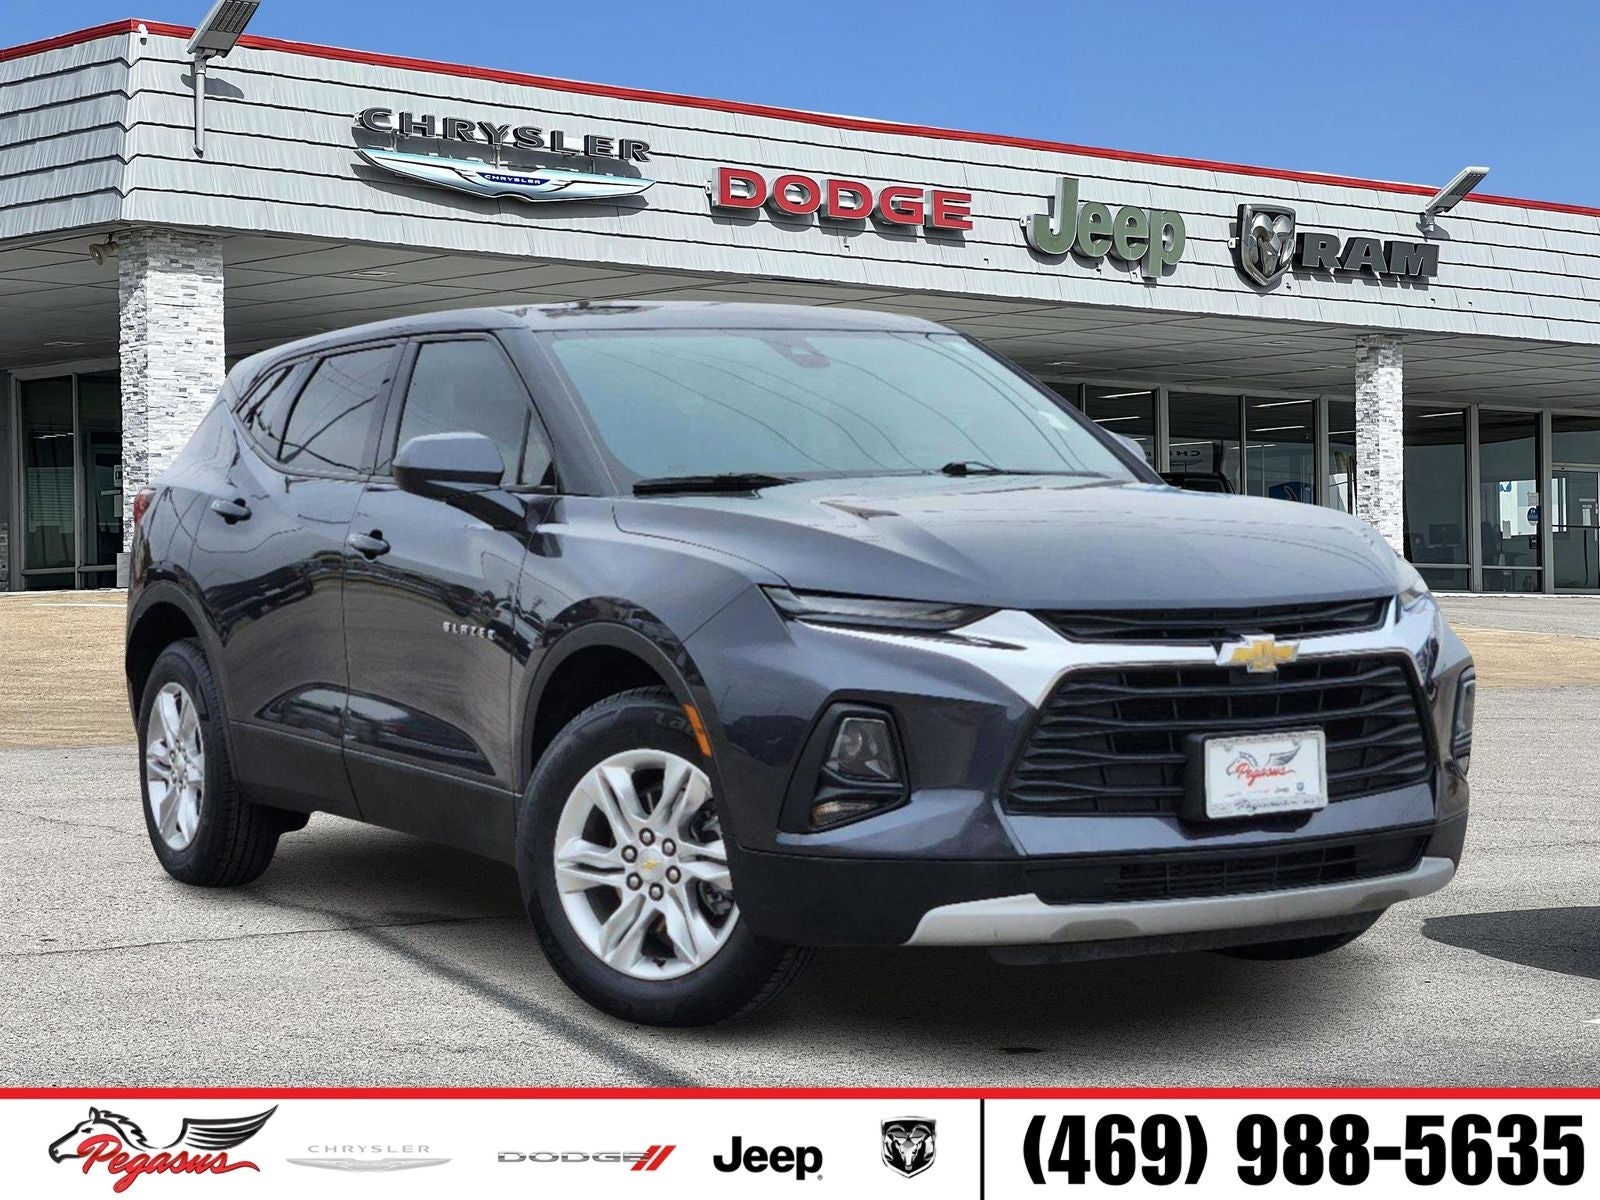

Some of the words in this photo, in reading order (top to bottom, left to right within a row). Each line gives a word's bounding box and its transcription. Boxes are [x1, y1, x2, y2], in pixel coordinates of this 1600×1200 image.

[358, 107, 651, 162] CHRYSLER
[484, 174, 541, 185] CHRYSLER
[711, 167, 974, 232] DODGE
[1028, 177, 1186, 278] Jeep
[1297, 232, 1440, 277] RAM
[442, 621, 496, 640] BLAZER
